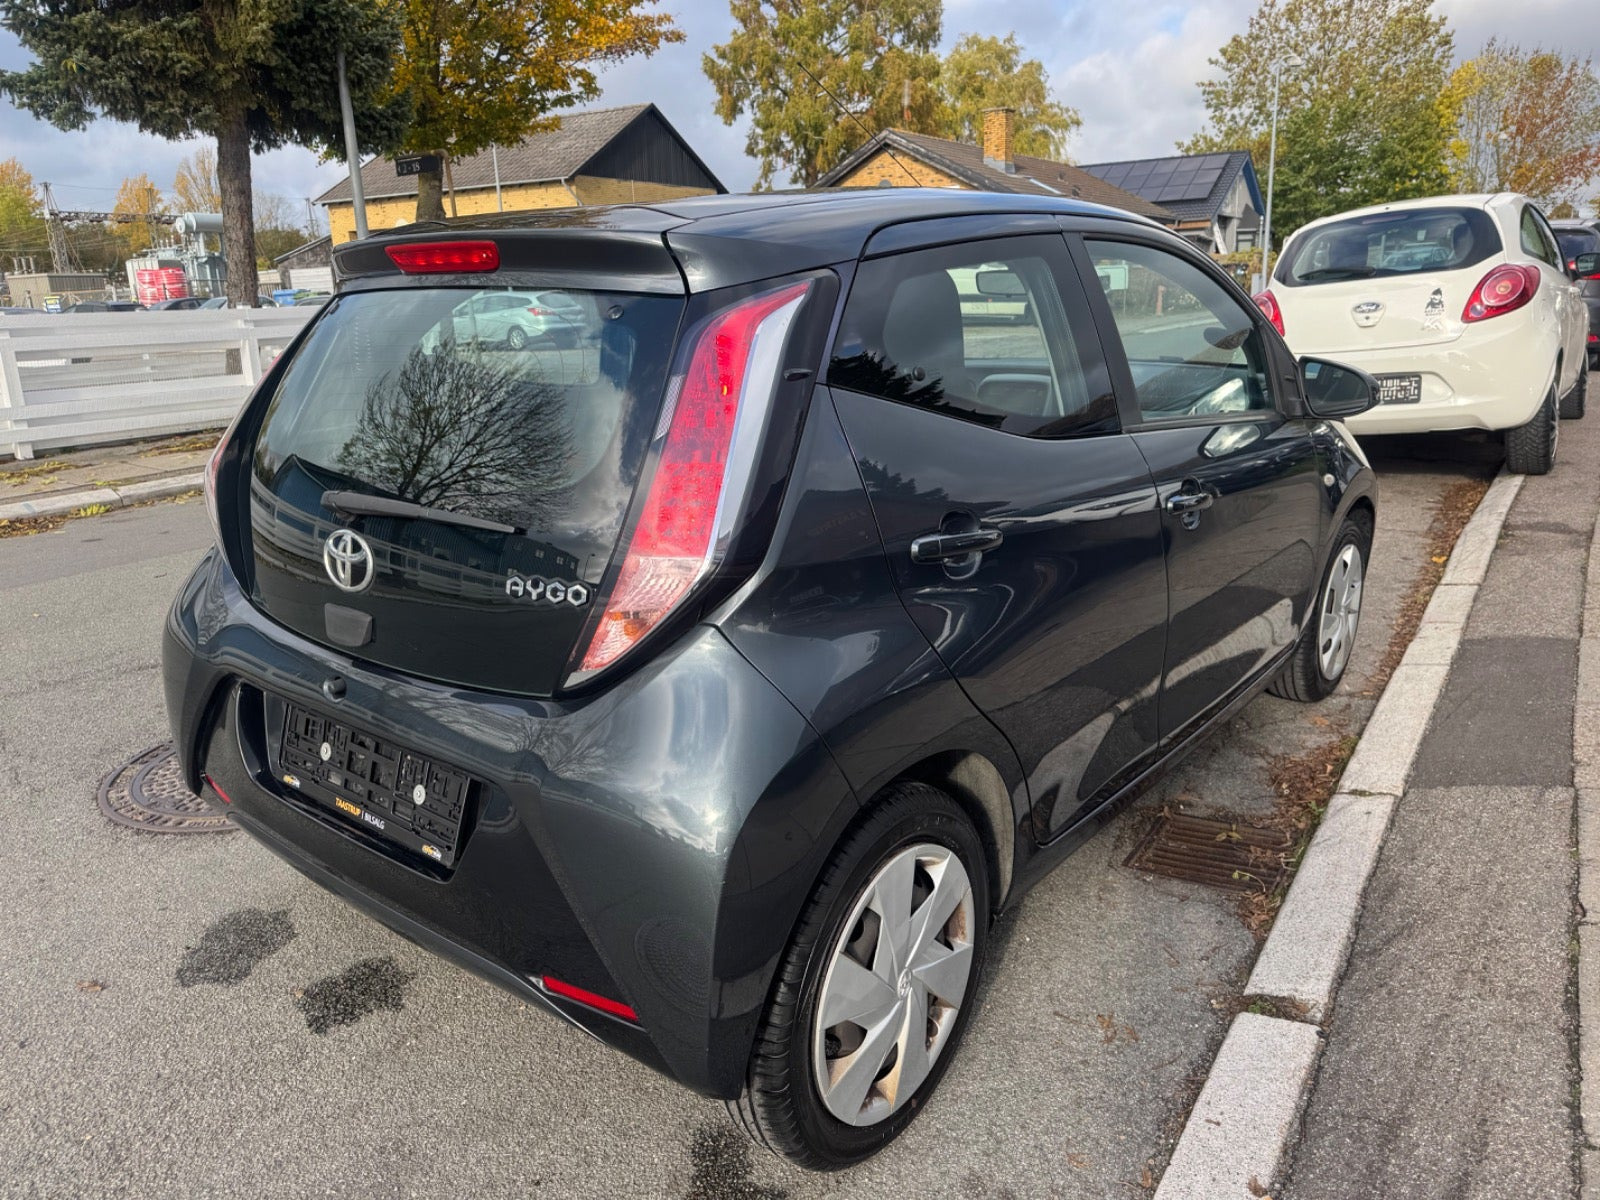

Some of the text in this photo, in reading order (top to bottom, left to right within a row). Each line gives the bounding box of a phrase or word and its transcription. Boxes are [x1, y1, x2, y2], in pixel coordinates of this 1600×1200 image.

[505, 576, 587, 606] AYGO
[335, 797, 385, 830] TAASTRUP BILSALG
